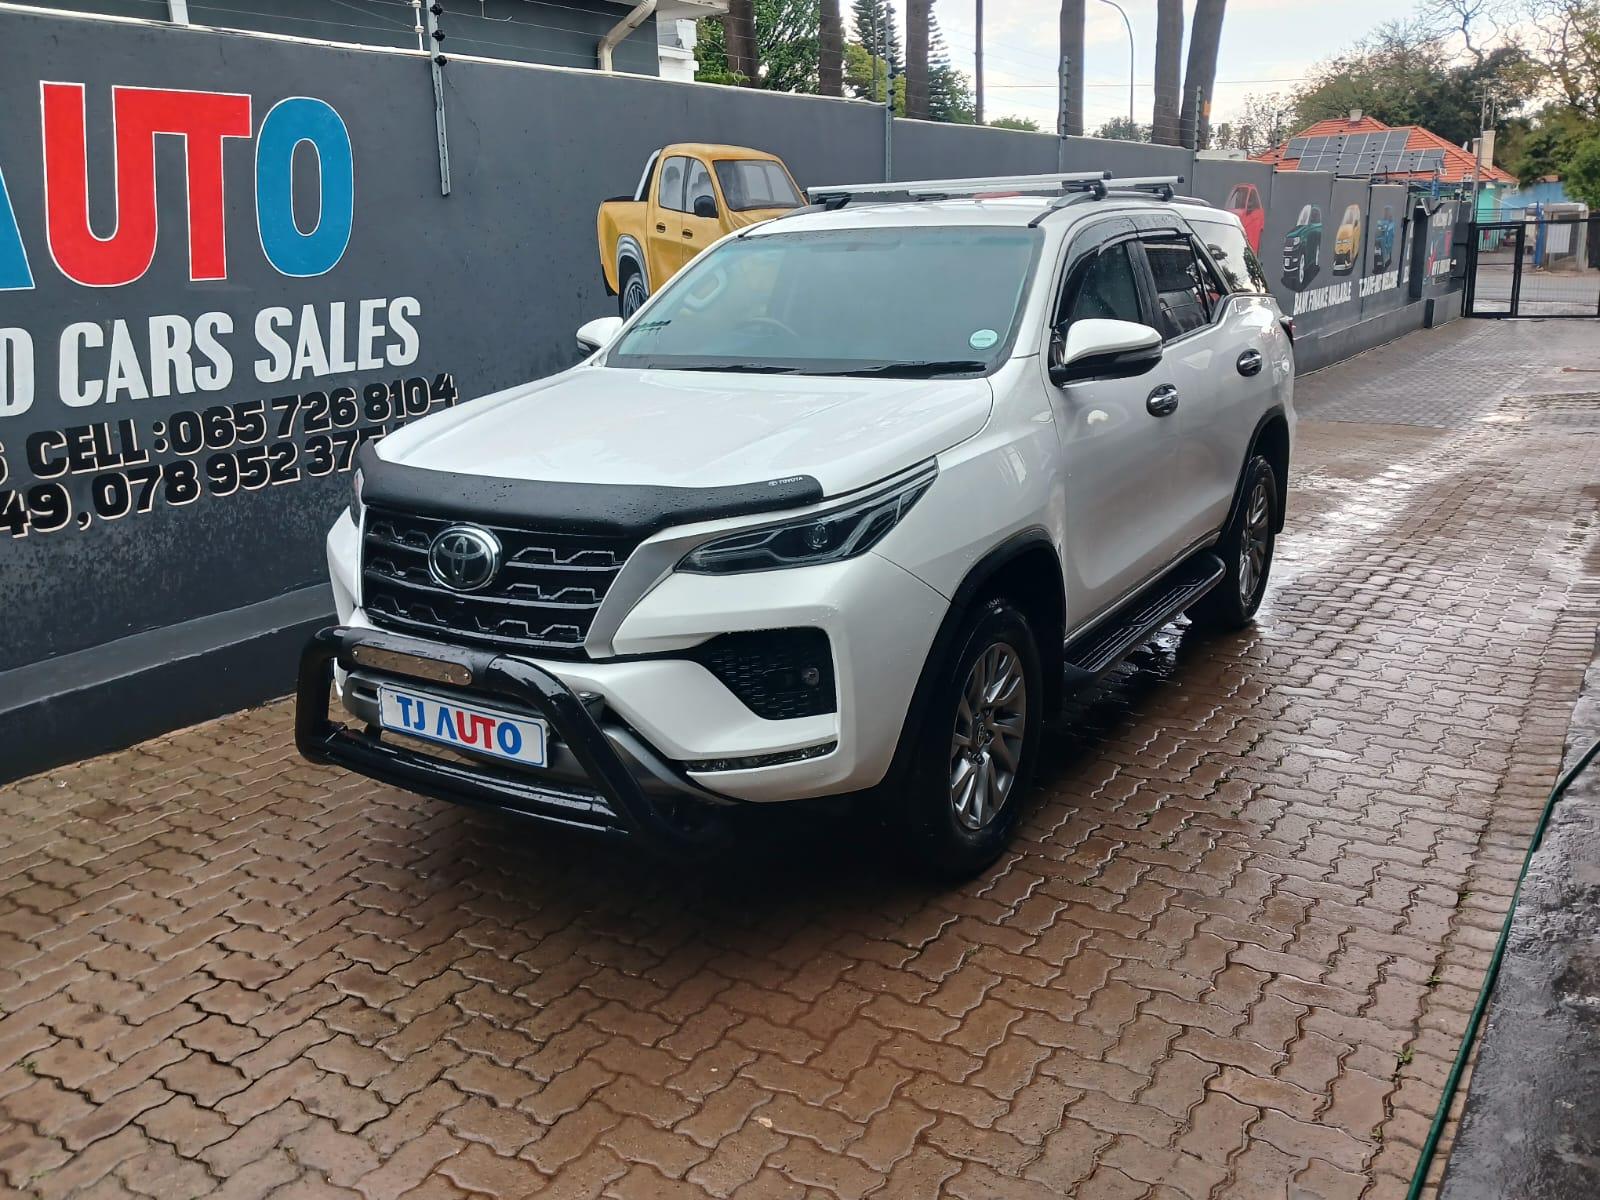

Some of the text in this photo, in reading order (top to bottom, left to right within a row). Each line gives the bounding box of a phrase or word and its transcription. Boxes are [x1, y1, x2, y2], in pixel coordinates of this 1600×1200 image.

[59, 311, 234, 408] CARS
[254, 296, 422, 384] SALES
[272, 386, 359, 439] 726
[363, 372, 459, 423] 8104
[206, 440, 301, 497] 952
[396, 695, 522, 755] TJ AUTO
